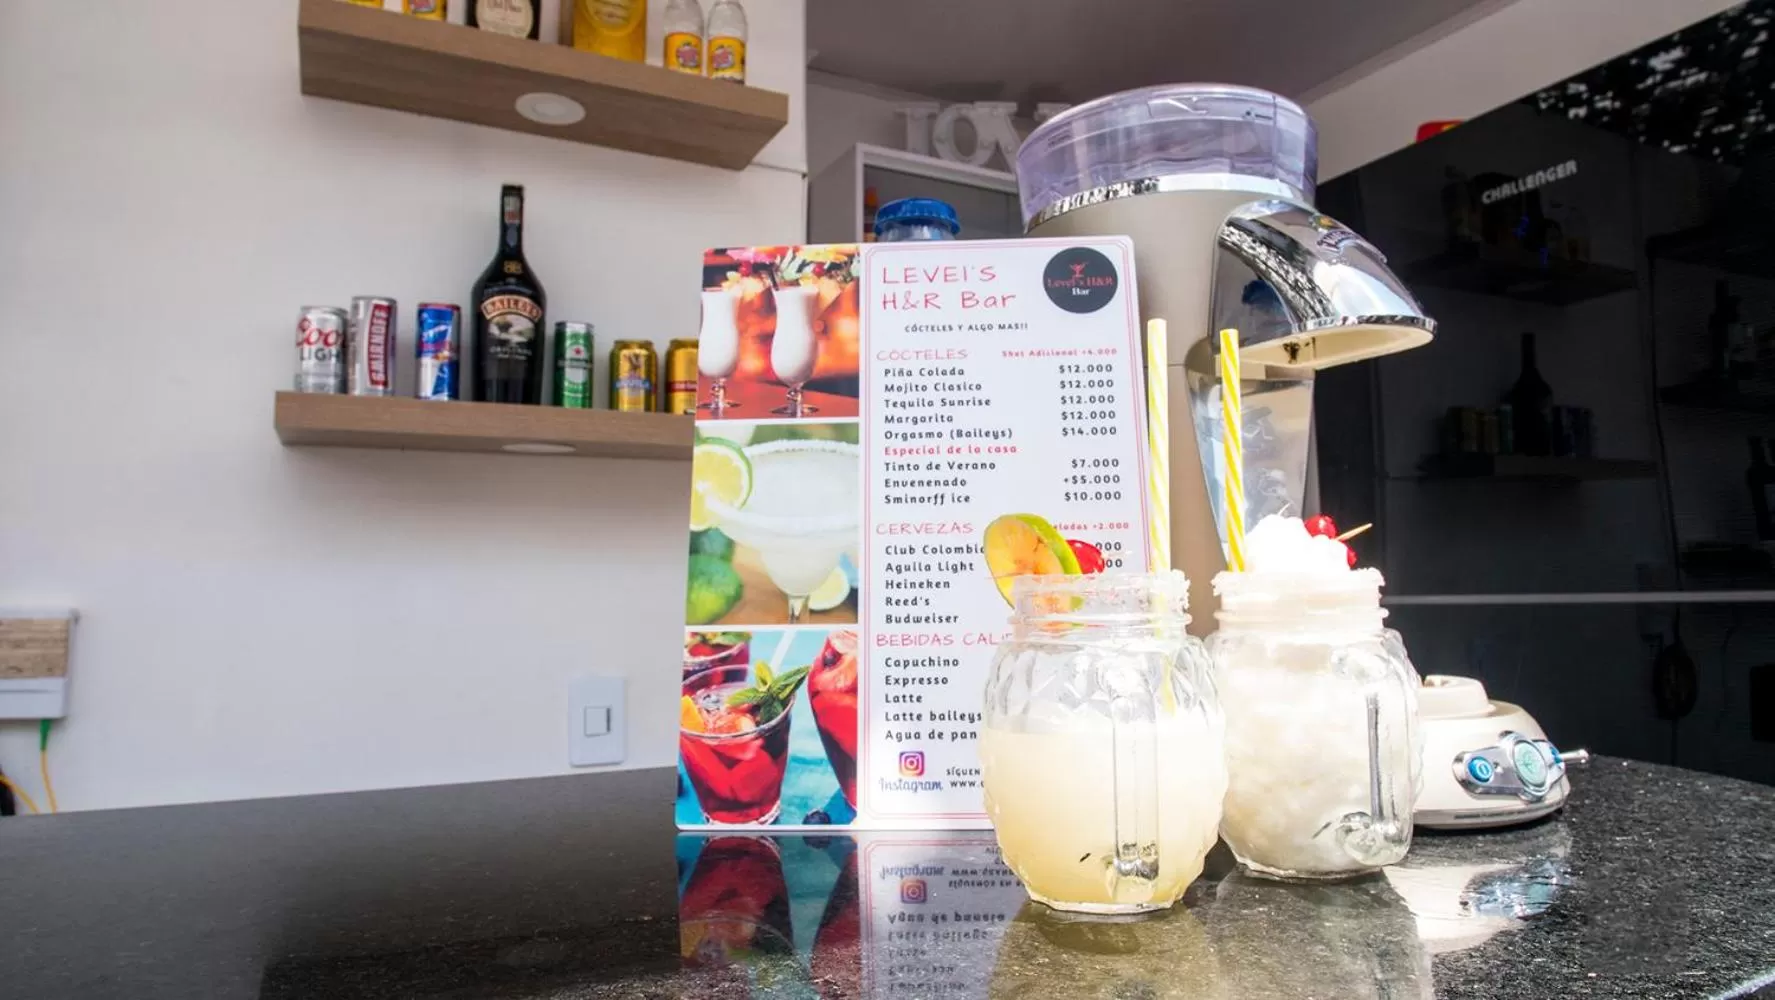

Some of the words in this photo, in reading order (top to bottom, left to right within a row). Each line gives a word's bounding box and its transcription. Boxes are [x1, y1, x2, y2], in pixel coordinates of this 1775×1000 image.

[1482, 159, 1577, 204] CHALLENGER
[1071, 287, 1090, 296] Bar
[882, 292, 942, 310] H&R
[961, 291, 1017, 308] Bar
[905, 323, 953, 333] CÓCTELES
[958, 324, 963, 332] Y
[968, 323, 994, 332] ALGO
[1002, 350, 1024, 358] Shot
[885, 367, 912, 377] Piña
[919, 367, 965, 377] Colada
[1059, 363, 1113, 374] $12.000
[885, 383, 927, 394] Mojito
[934, 383, 982, 392] Clasico
[1060, 379, 1114, 389] $12.000
[884, 399, 934, 409] Tequila
[941, 397, 991, 407] Sunrise
[1061, 395, 1115, 405] $12.000
[884, 414, 953, 425] Margarita
[1062, 410, 1116, 420] $12.000
[884, 430, 943, 442] Orgasmo
[950, 428, 1013, 441] (Baileys)
[1062, 426, 1117, 437] $14.000
[884, 445, 941, 457] Especial
[947, 445, 961, 454] de
[968, 445, 981, 454] la
[884, 462, 920, 472] Tinto
[926, 461, 940, 471] de
[948, 461, 996, 470] Verano
[1071, 458, 1119, 468] $7.000
[884, 478, 967, 488] Envenenado
[1063, 475, 1121, 484] +$5.000
[884, 494, 945, 505] Sminorff
[951, 494, 970, 504] ice
[1064, 491, 1122, 502] $10.000
[876, 523, 973, 535] CERVEZAS
[885, 544, 916, 555] Club
[885, 562, 931, 573] Aguila
[938, 562, 974, 573] Light
[885, 579, 950, 589] Heineken
[885, 597, 930, 606] Reed's
[885, 613, 959, 624] Budweiser
[876, 633, 954, 647] BEBIDAS
[884, 656, 959, 669] Capuchino
[884, 675, 949, 687] Expresso
[884, 693, 923, 703] Latte
[884, 711, 923, 722] Latte
[929, 711, 982, 723] baileys
[884, 730, 921, 742] Agua
[928, 729, 944, 740] de
[880, 778, 943, 792] Instagram
